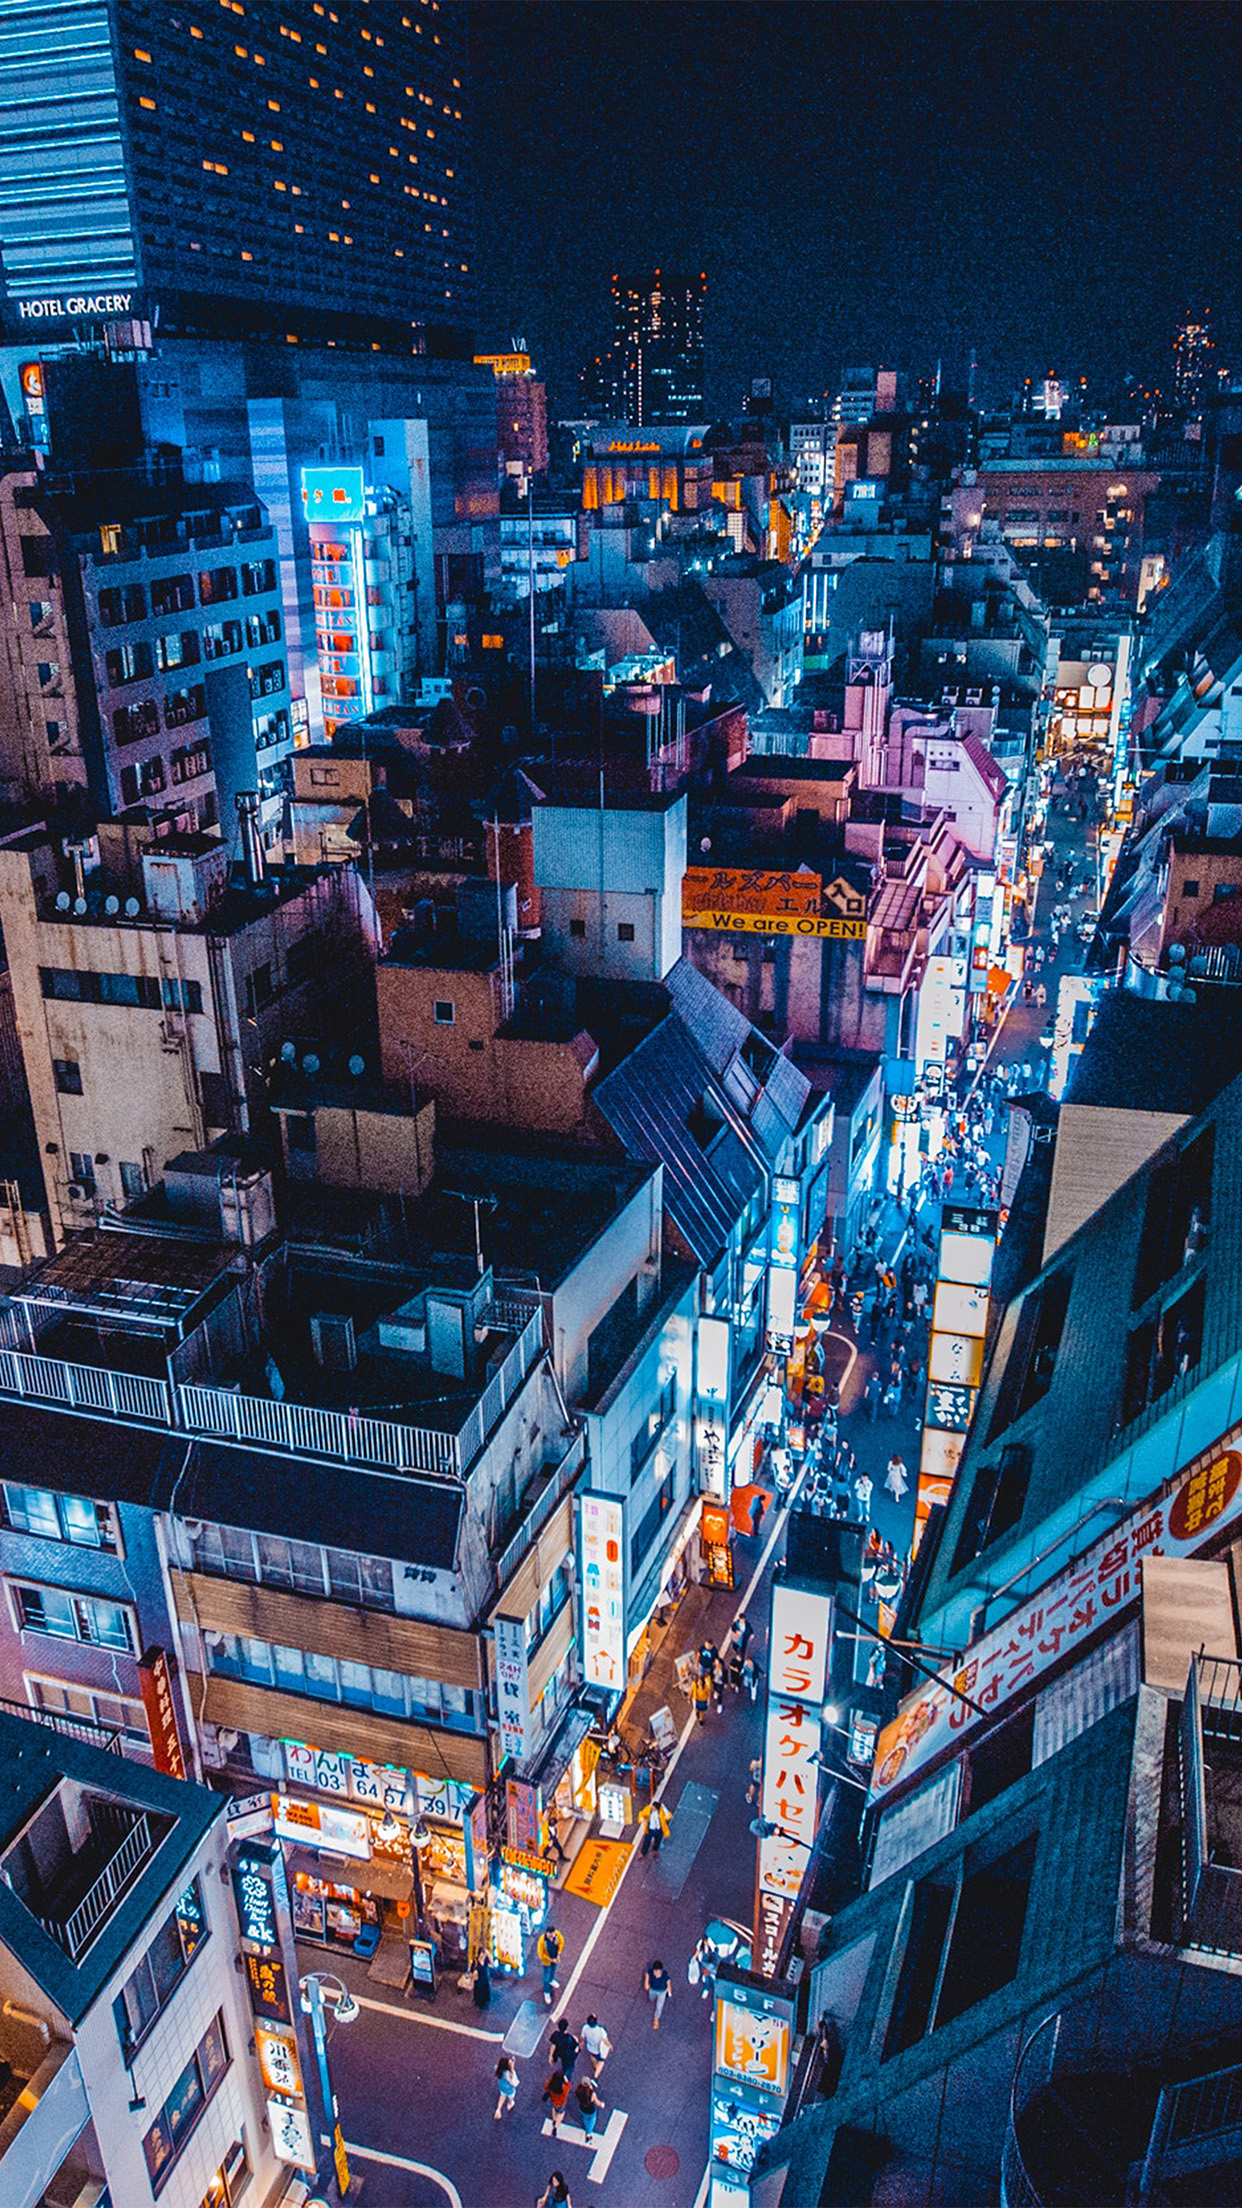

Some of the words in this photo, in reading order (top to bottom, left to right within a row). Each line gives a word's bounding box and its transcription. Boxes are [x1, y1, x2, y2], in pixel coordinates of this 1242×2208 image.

[20, 300, 66, 318] HOTEL
[66, 294, 131, 315] GRACERY
[831, 883, 862, 913] 入口
[713, 914, 745, 929] We
[753, 919, 788, 932] are
[796, 920, 863, 938] OPEN!
